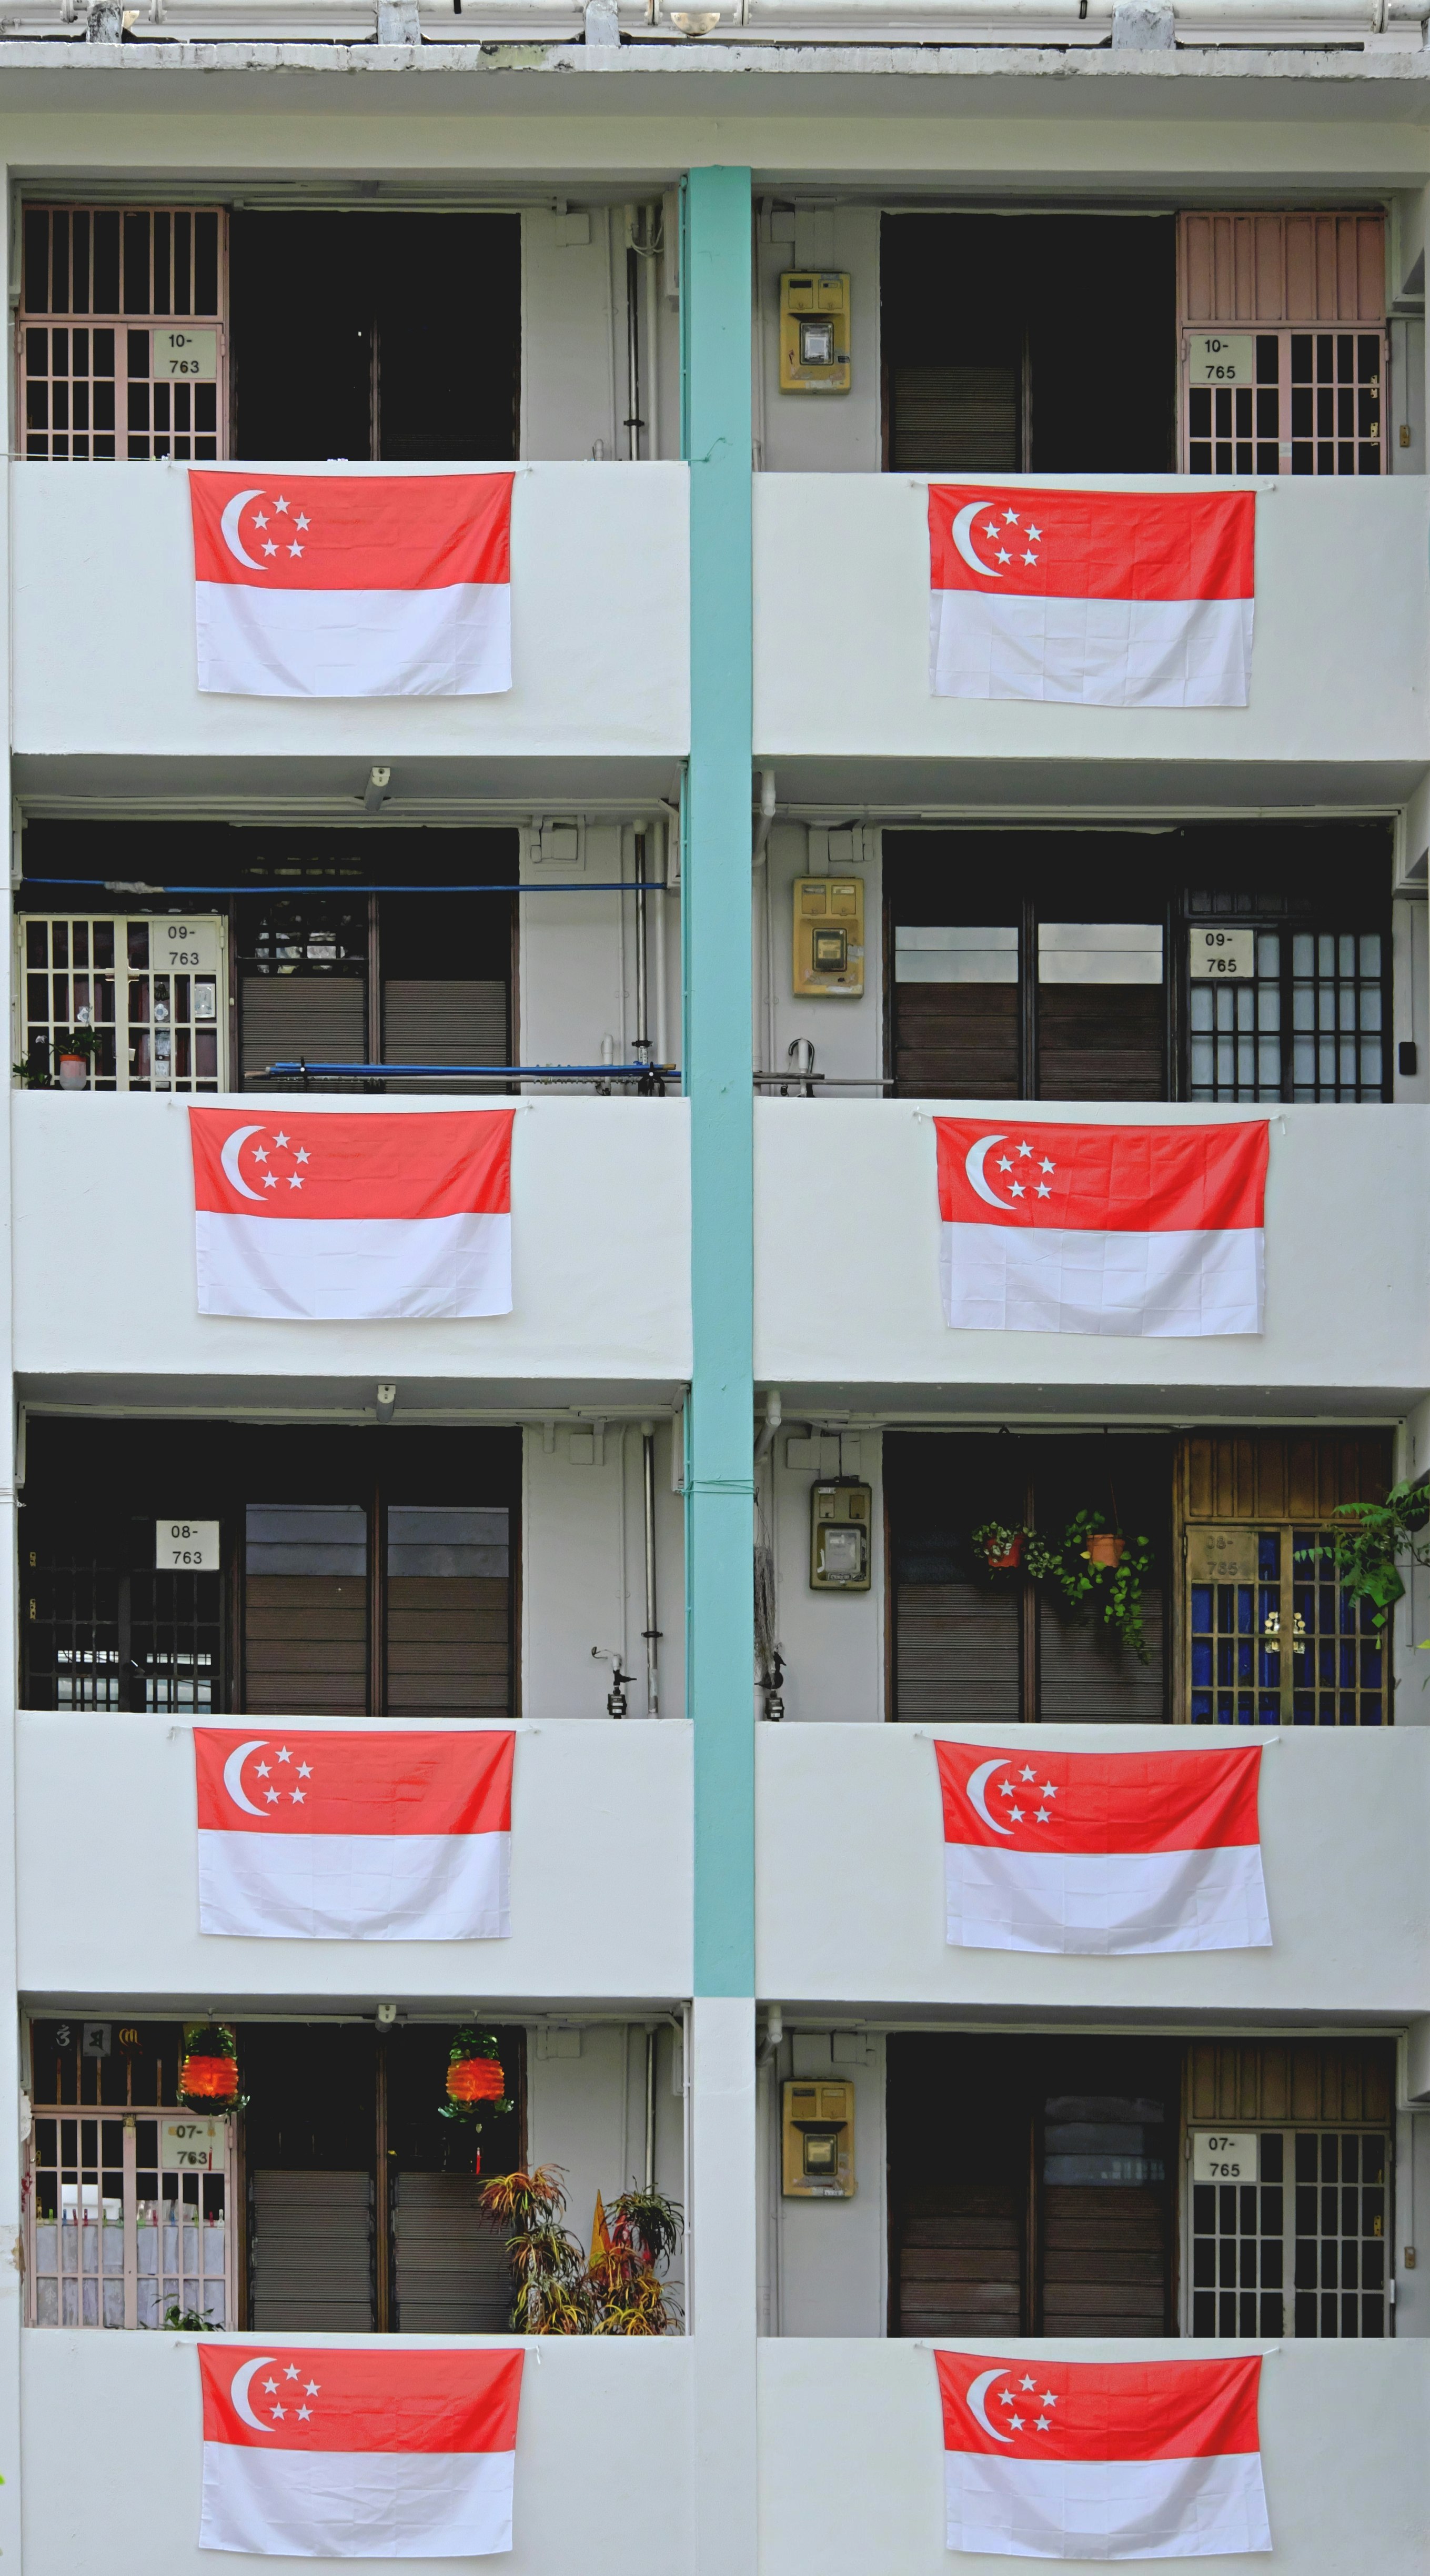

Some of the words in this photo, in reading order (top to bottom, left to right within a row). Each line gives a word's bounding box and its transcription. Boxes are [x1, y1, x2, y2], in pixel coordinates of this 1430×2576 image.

[169, 335, 193, 347] 10-
[1205, 339, 1228, 353] 10-
[170, 360, 199, 374] 763
[1206, 366, 1235, 379] 765
[168, 926, 195, 939] 09-
[1205, 933, 1233, 946] 09-
[169, 952, 199, 965] 763
[1207, 959, 1236, 972] 765
[172, 1526, 198, 1538] 08-
[1206, 1536, 1233, 1549] 08-
[173, 1552, 202, 1564] 763
[1207, 1561, 1237, 1575] 765
[177, 2125, 203, 2139] 07-
[1209, 2138, 1235, 2150] 07-
[177, 2151, 207, 2165] 763
[1210, 2164, 1240, 2177] 765
